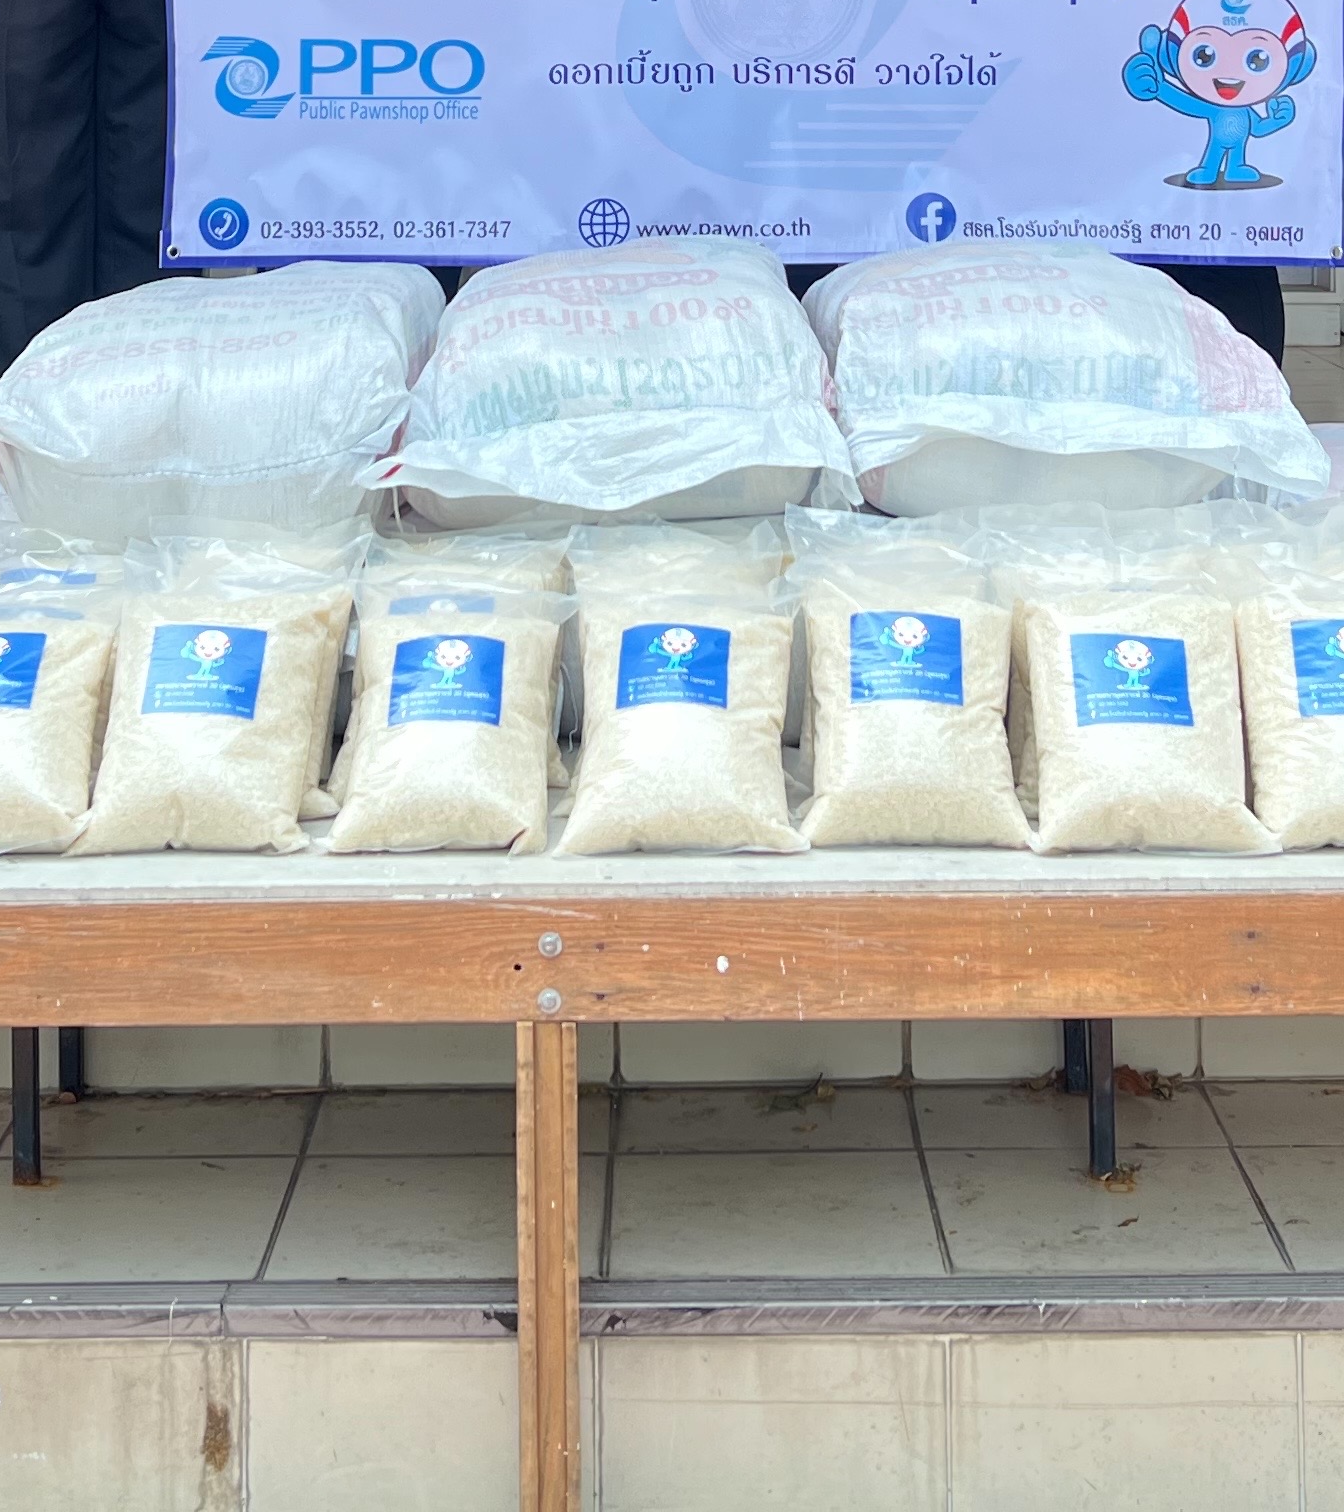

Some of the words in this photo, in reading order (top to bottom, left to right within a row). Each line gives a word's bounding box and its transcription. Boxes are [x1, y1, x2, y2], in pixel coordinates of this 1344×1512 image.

[299, 38, 486, 95] PPO
[548, 49, 716, 93] ดอกเบี้ยถูก
[732, 56, 857, 86] บริการดี
[874, 51, 1000, 87] วางใจได้
[299, 100, 346, 121] Public
[349, 100, 430, 124] Pawnshop
[432, 100, 480, 121] Office
[260, 220, 385, 241] 02-393-3552,
[392, 220, 513, 239] 02-361-7347
[635, 216, 812, 238] www.pawn.co.th
[1149, 222, 1191, 241] สาขา
[1197, 222, 1223, 242] 20
[1244, 222, 1305, 248] อุดมสุข
